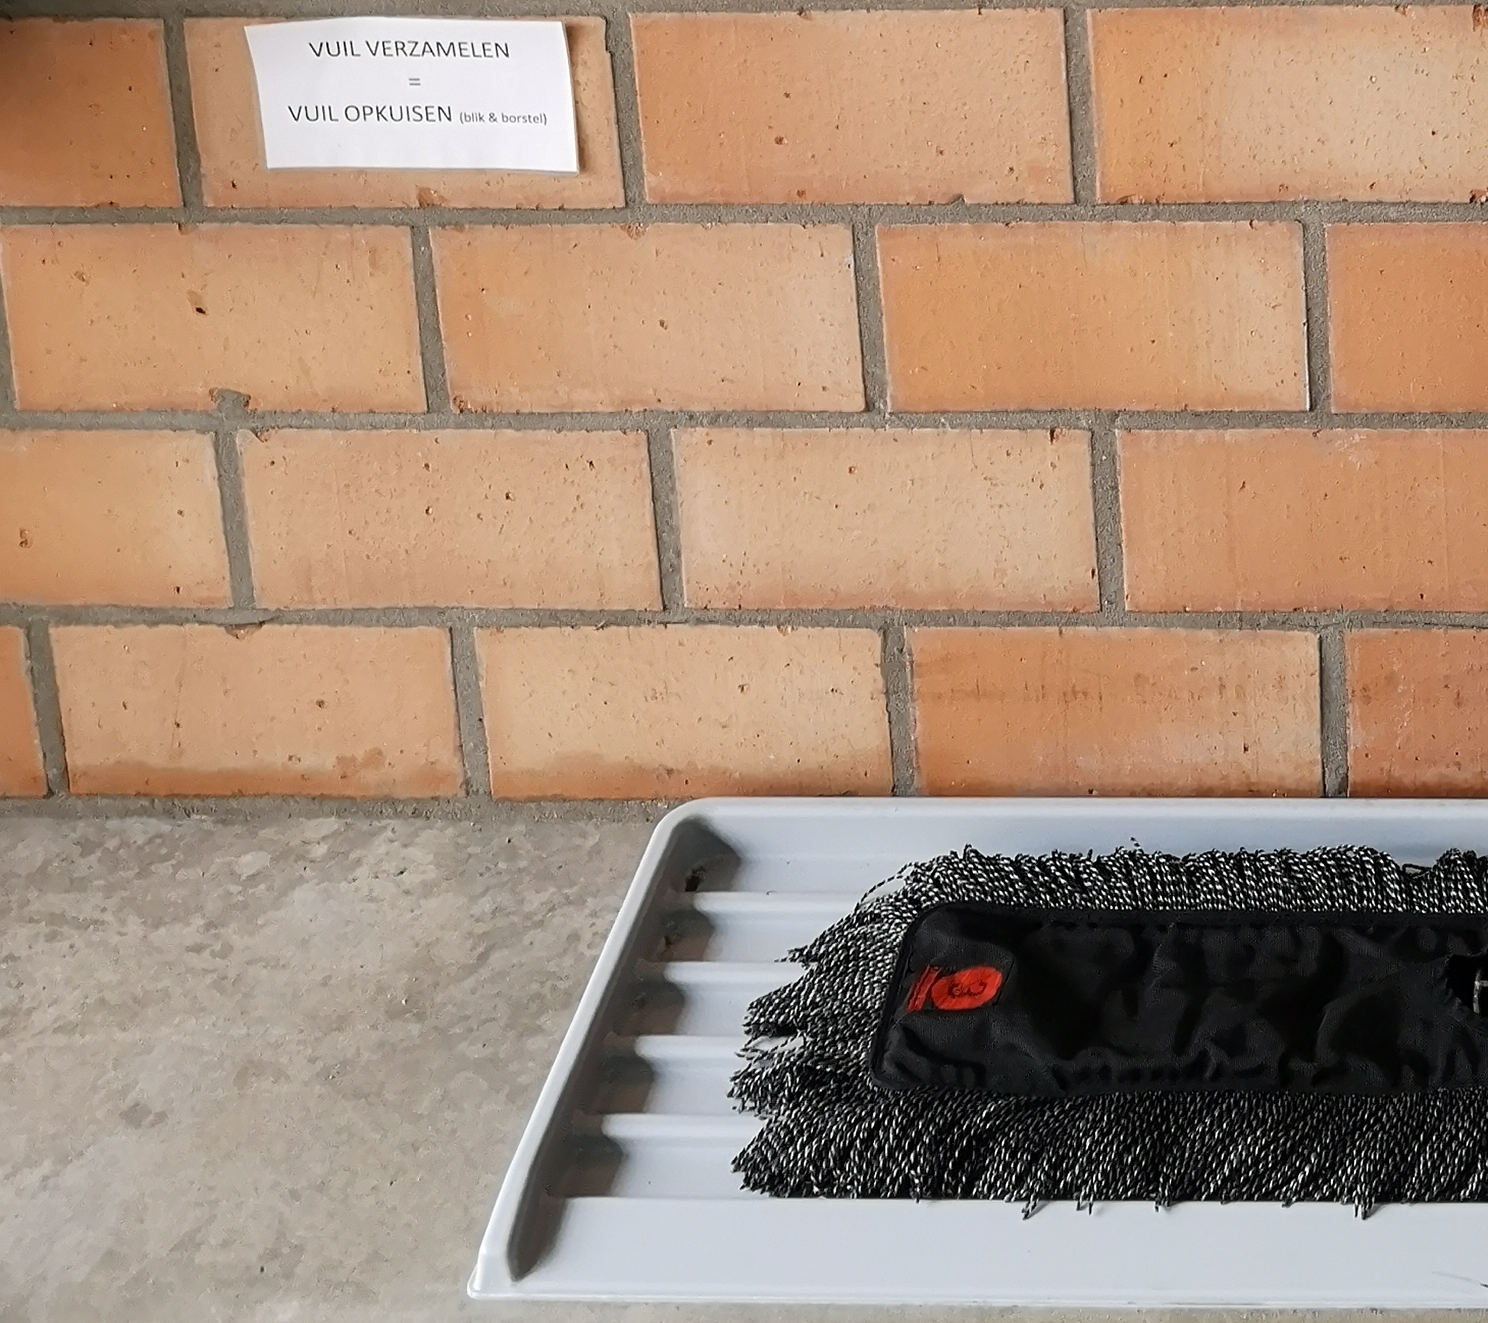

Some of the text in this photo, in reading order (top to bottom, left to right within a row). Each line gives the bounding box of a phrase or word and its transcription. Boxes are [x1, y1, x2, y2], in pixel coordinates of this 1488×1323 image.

[308, 40, 511, 59] VUIL VERZAMELEN
[287, 105, 339, 122] VUIL
[344, 105, 452, 123] OPKUISEN
[458, 111, 485, 124] (blik
[501, 112, 548, 126] borstel)
